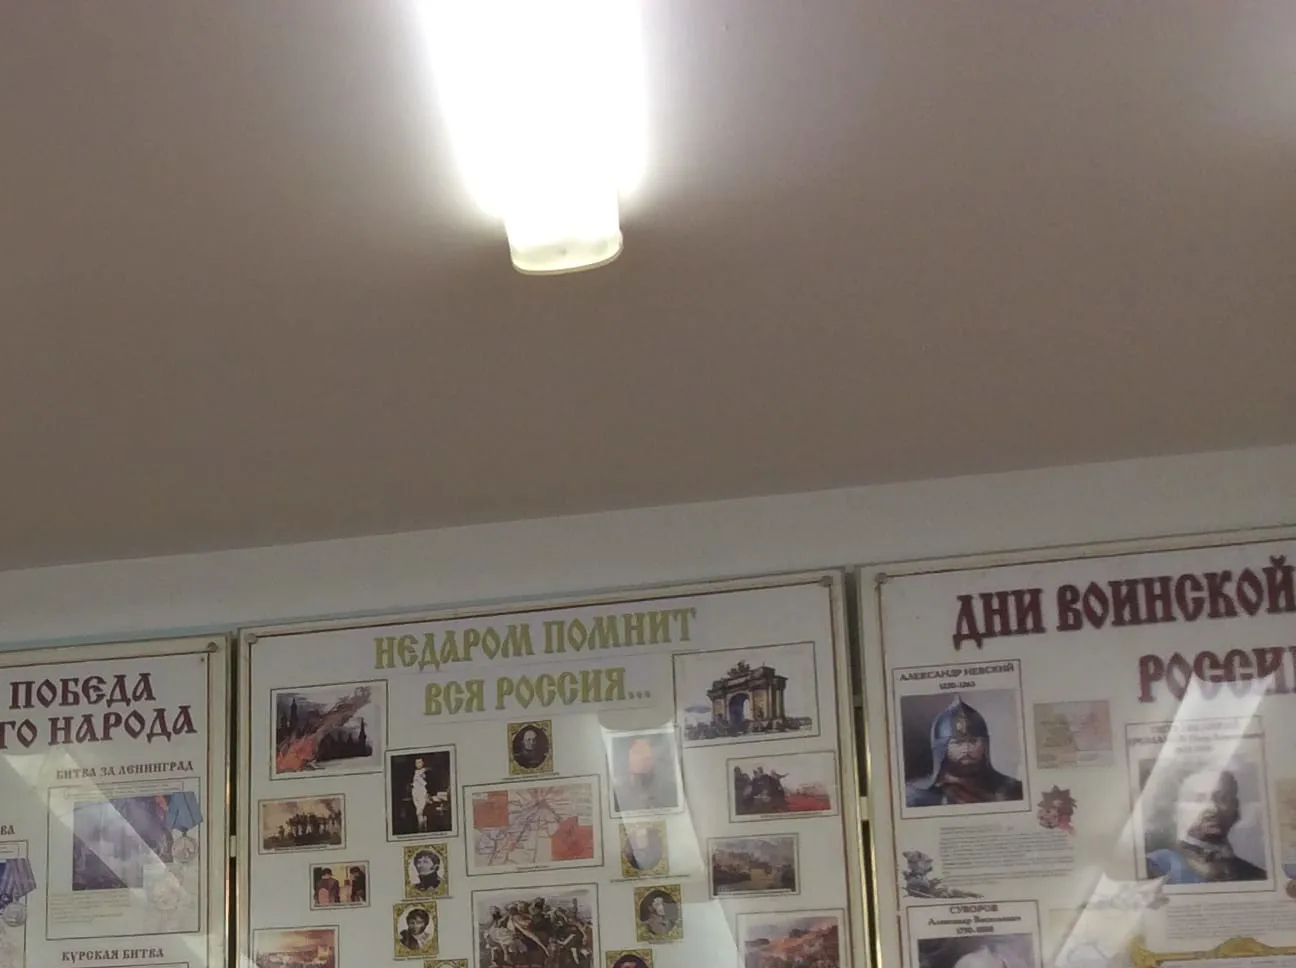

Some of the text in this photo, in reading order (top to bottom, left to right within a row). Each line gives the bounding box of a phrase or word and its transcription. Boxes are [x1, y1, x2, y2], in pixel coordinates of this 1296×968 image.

[953, 554, 1296, 651] ДНИ ВОИНСКОЙ
[373, 607, 697, 673] НЕДАРОМ ПОМНИТ
[9, 672, 156, 708] ПОБЕДА
[424, 667, 651, 716] ВСЯ РОССИЯ...
[1138, 645, 1296, 702] РОССИ
[48, 705, 198, 746] НАРОДА
[56, 760, 194, 780] БИТВА ЗА ЛЕНИНГРАД
[62, 948, 164, 964] КУРСКАЯ БИТВА
